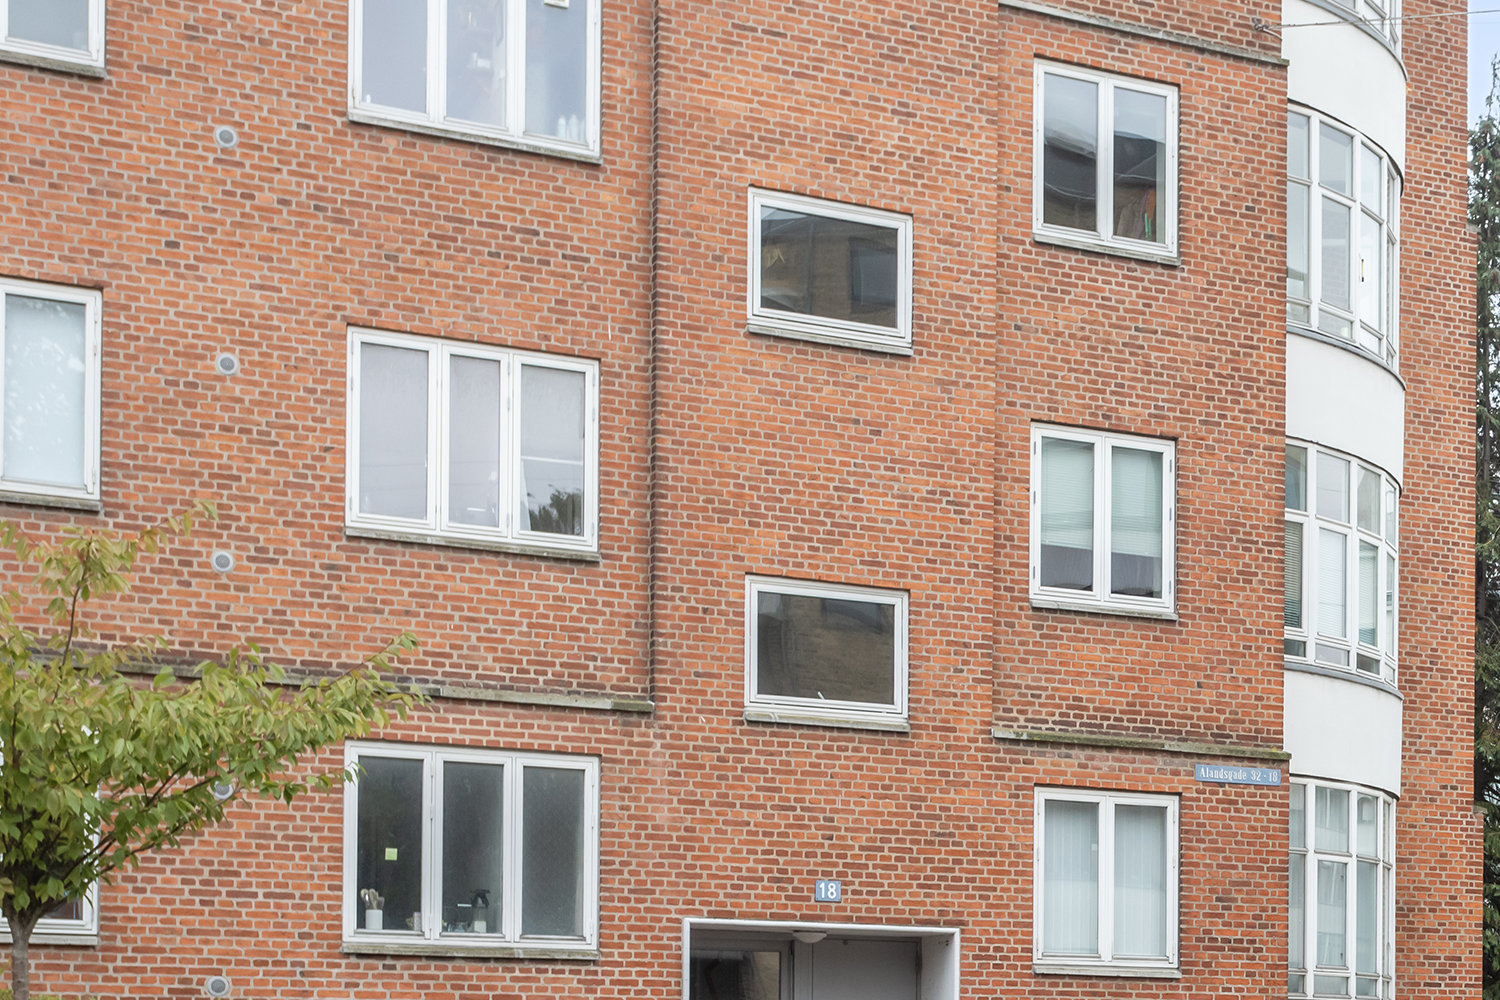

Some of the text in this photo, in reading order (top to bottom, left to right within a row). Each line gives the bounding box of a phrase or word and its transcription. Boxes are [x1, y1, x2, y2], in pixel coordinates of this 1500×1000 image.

[1251, 769, 1262, 782] 32
[1269, 771, 1278, 783] 18
[819, 882, 837, 899] 18
